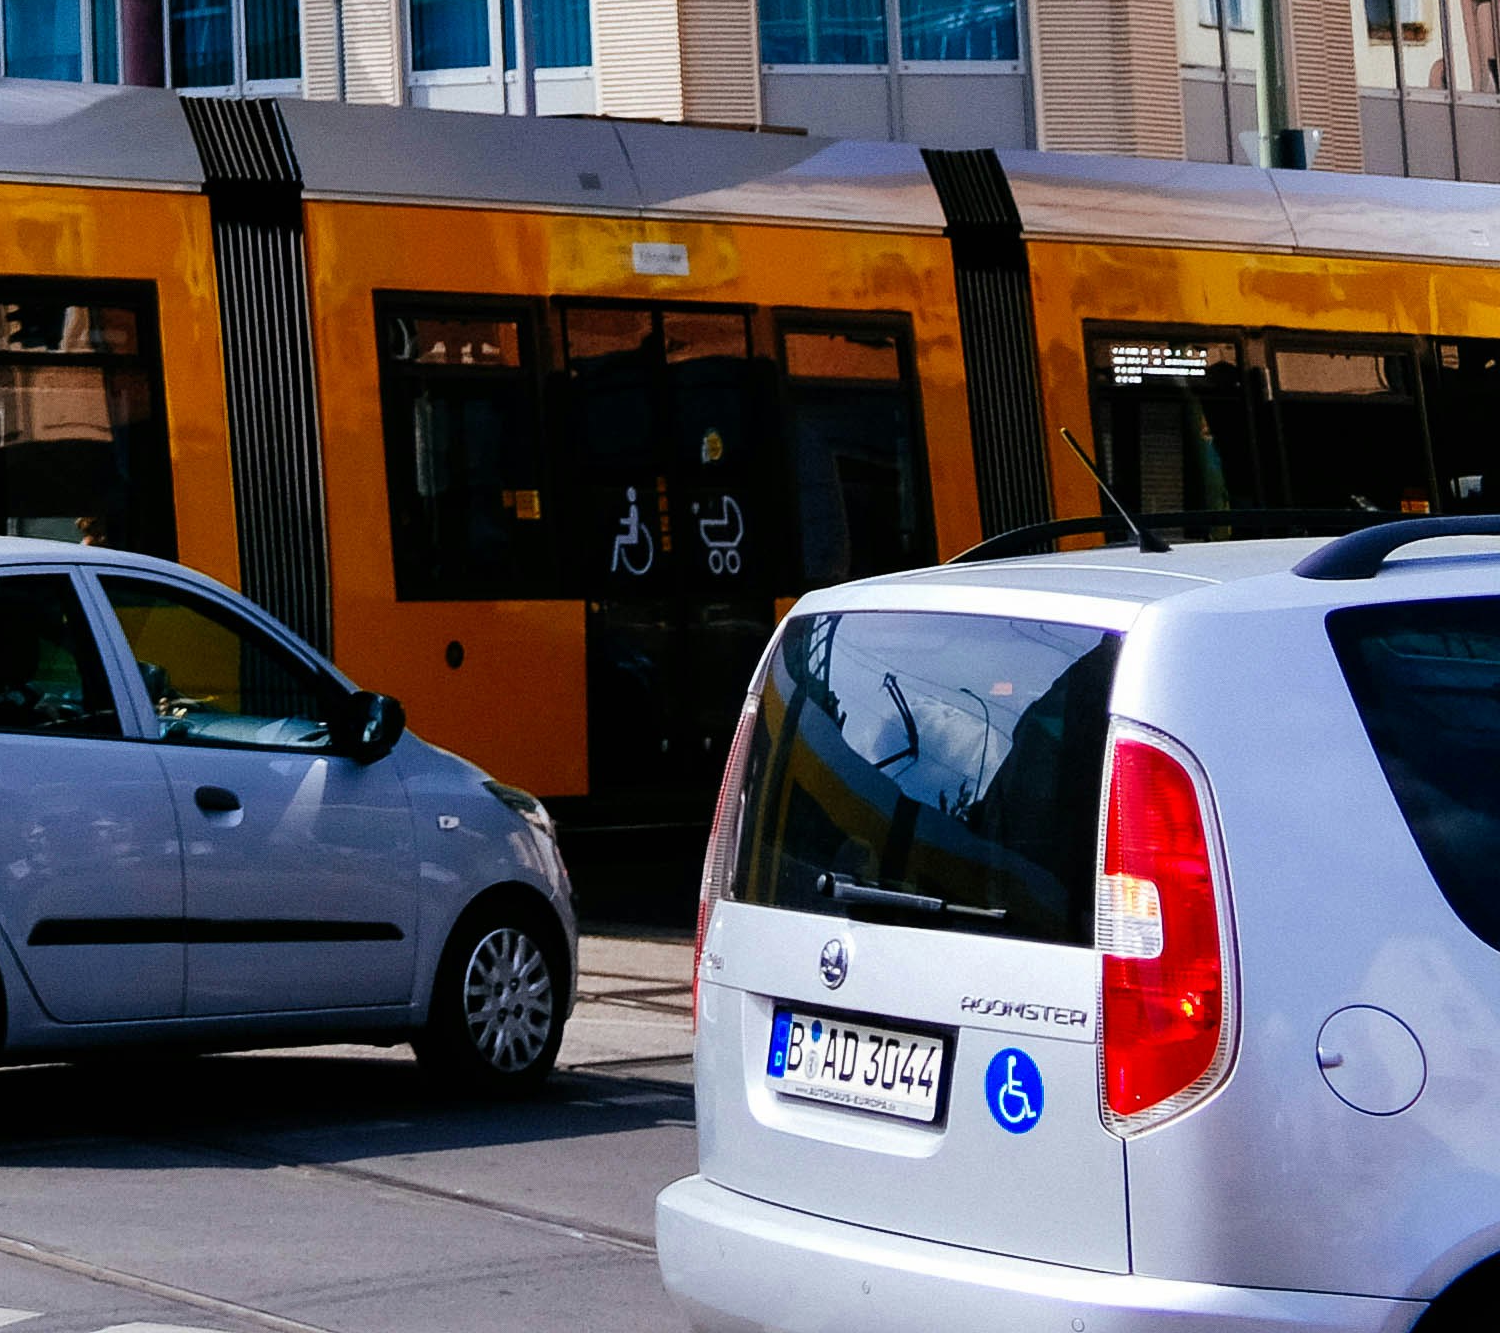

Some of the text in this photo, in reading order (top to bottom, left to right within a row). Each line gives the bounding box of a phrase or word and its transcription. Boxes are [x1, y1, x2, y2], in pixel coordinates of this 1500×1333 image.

[961, 995, 1088, 1027] ROOMSTER
[787, 1021, 937, 1097] B AD 3044
